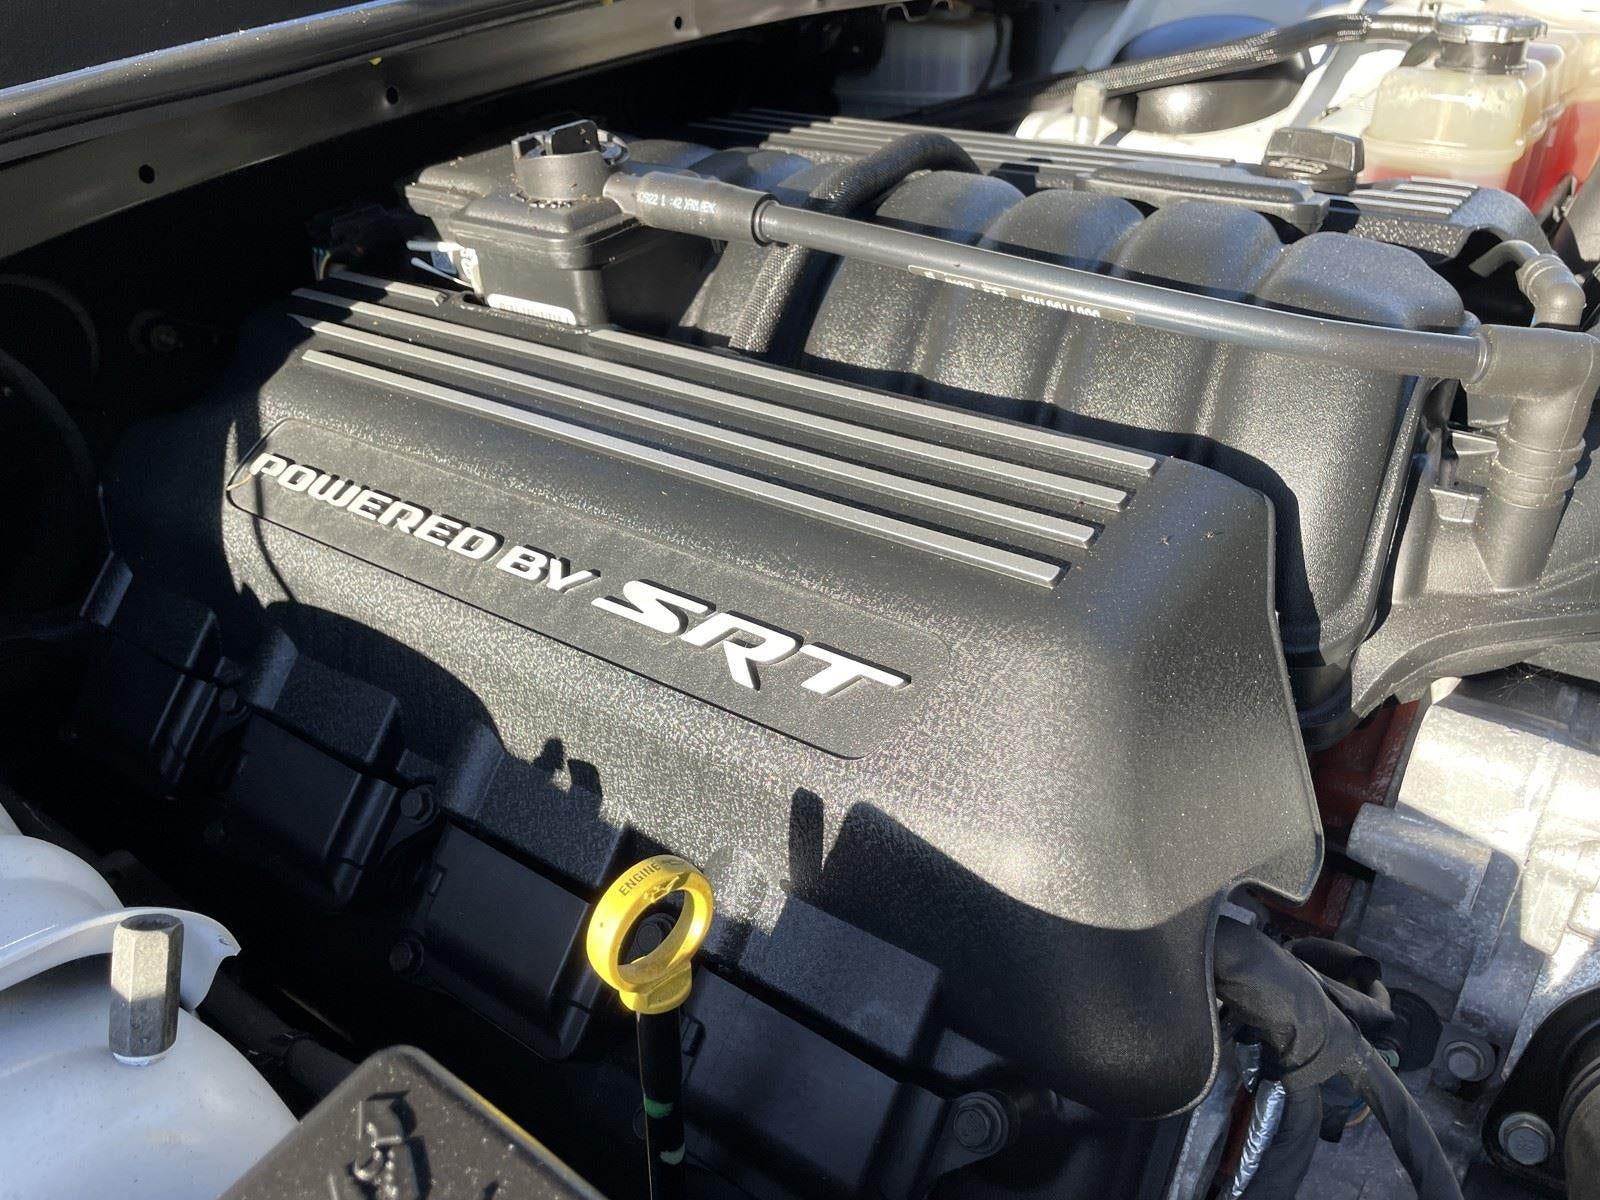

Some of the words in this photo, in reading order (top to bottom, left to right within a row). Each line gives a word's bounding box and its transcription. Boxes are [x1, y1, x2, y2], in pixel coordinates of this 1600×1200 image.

[250, 452, 501, 562] POWERED
[496, 544, 598, 593] BY
[590, 578, 910, 697] SRT
[618, 861, 662, 897] ENGINE
